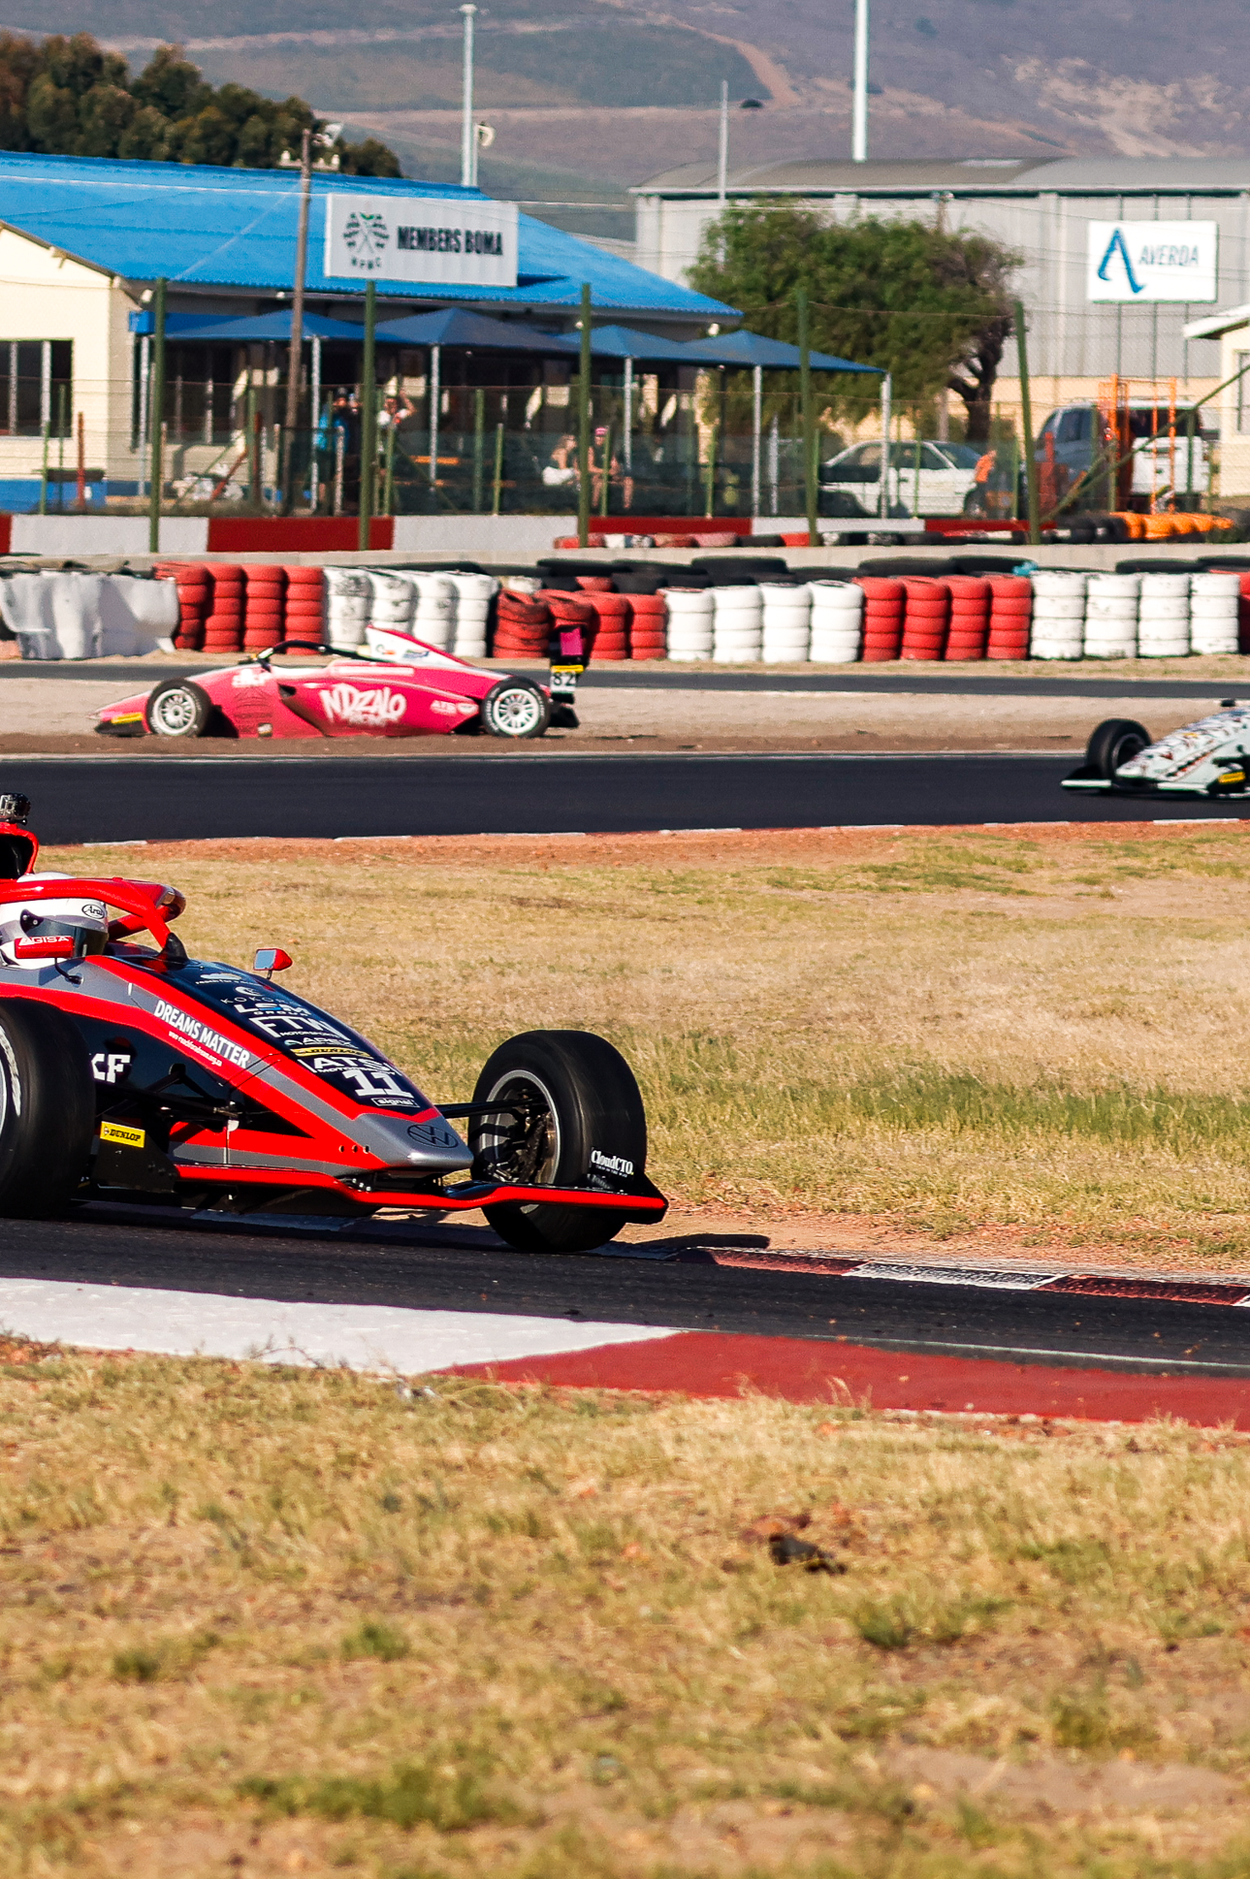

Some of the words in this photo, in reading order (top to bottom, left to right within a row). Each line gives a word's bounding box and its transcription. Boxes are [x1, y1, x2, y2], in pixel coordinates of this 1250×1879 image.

[397, 225, 461, 253] MEMBERS
[465, 230, 504, 256] BOMA
[1138, 245, 1199, 267] AVERDA
[154, 1000, 201, 1038] DREAMS
[199, 1028, 251, 1068] MATTER
[342, 1069, 414, 1098] 11
[110, 1129, 141, 1142] DUNLOP
